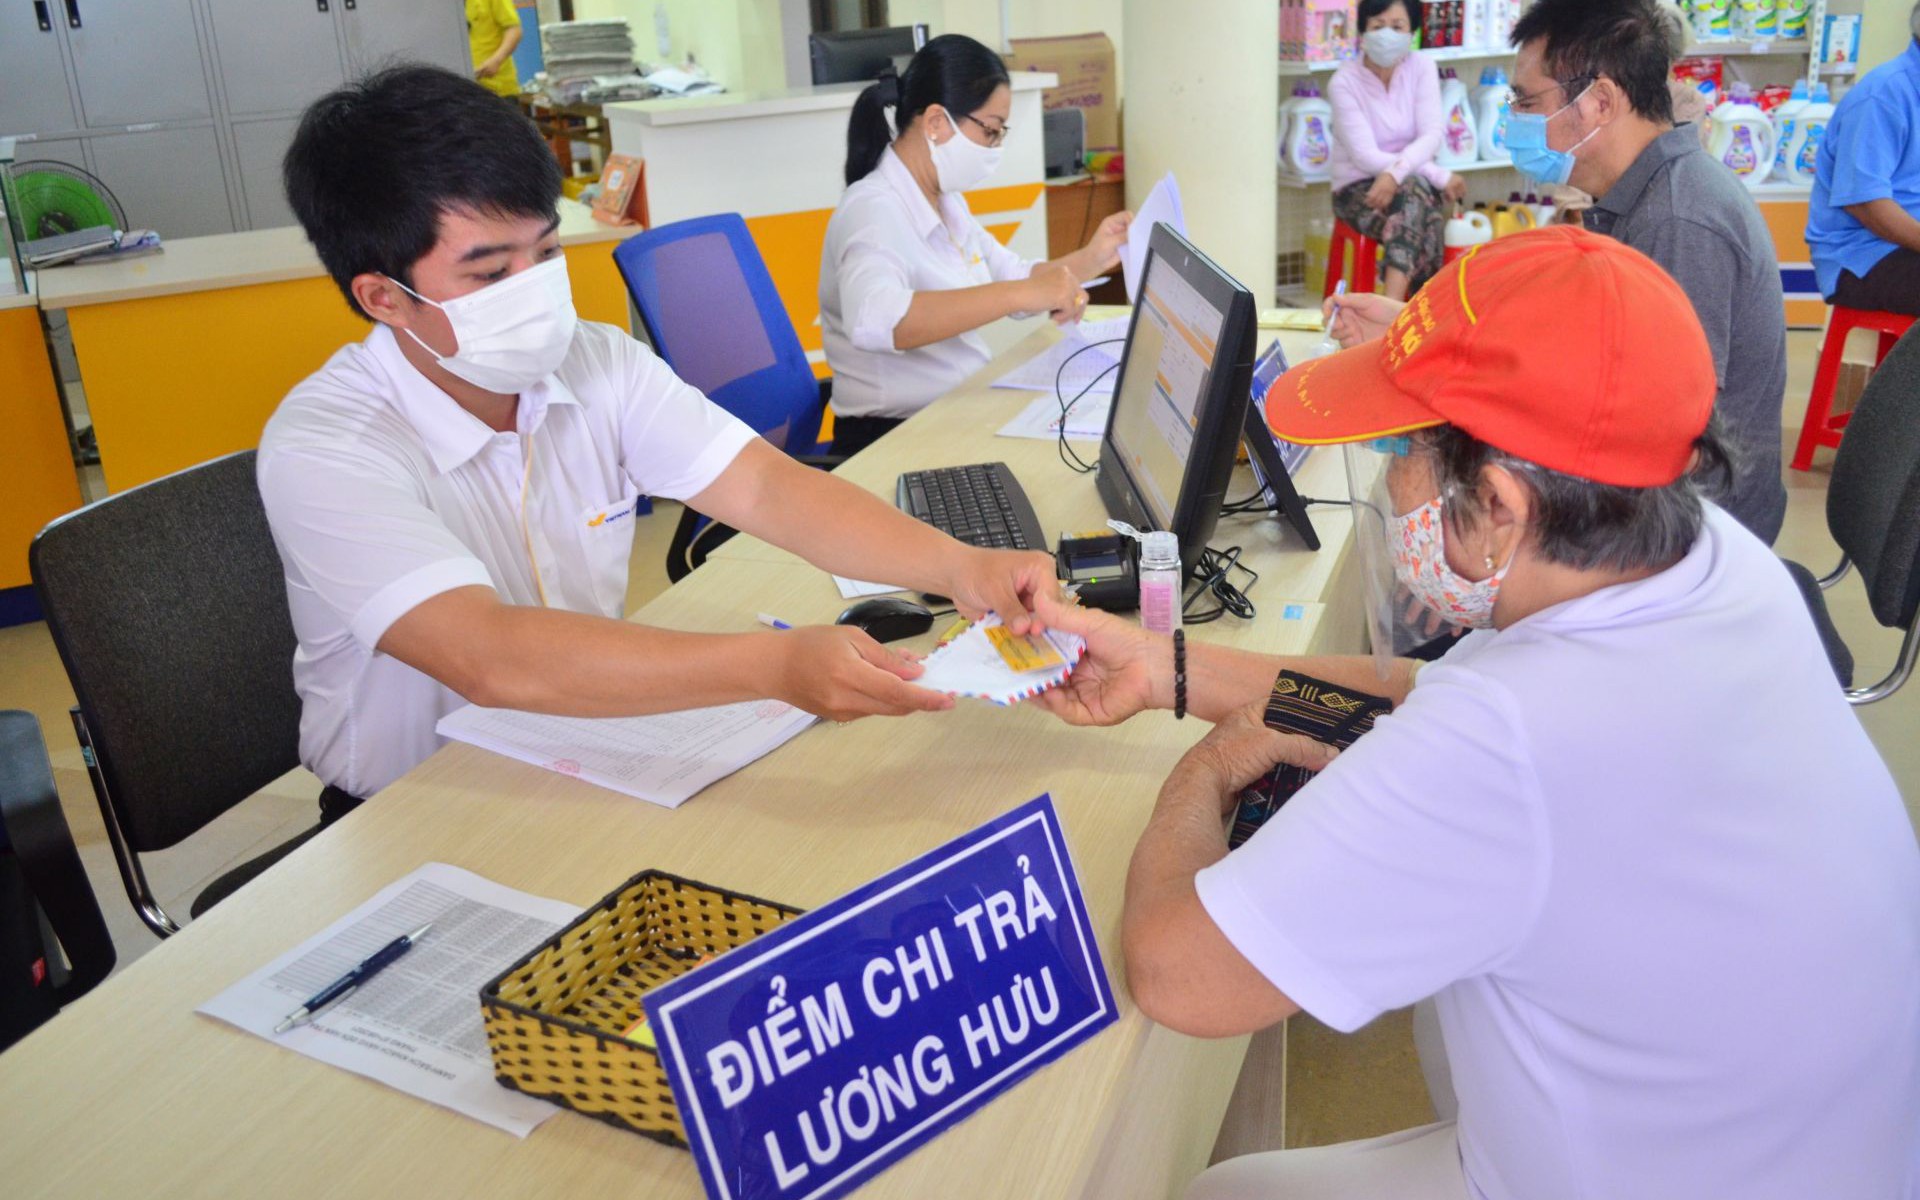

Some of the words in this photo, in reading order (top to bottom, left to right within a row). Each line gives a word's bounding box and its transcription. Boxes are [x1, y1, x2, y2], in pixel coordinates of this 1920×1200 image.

[706, 975, 855, 1109] ĐIỂM
[862, 927, 954, 1018] CHI
[954, 854, 1057, 962] TRẢ
[764, 1034, 954, 1190] LƯƠNG
[959, 966, 1060, 1069] HƯU
